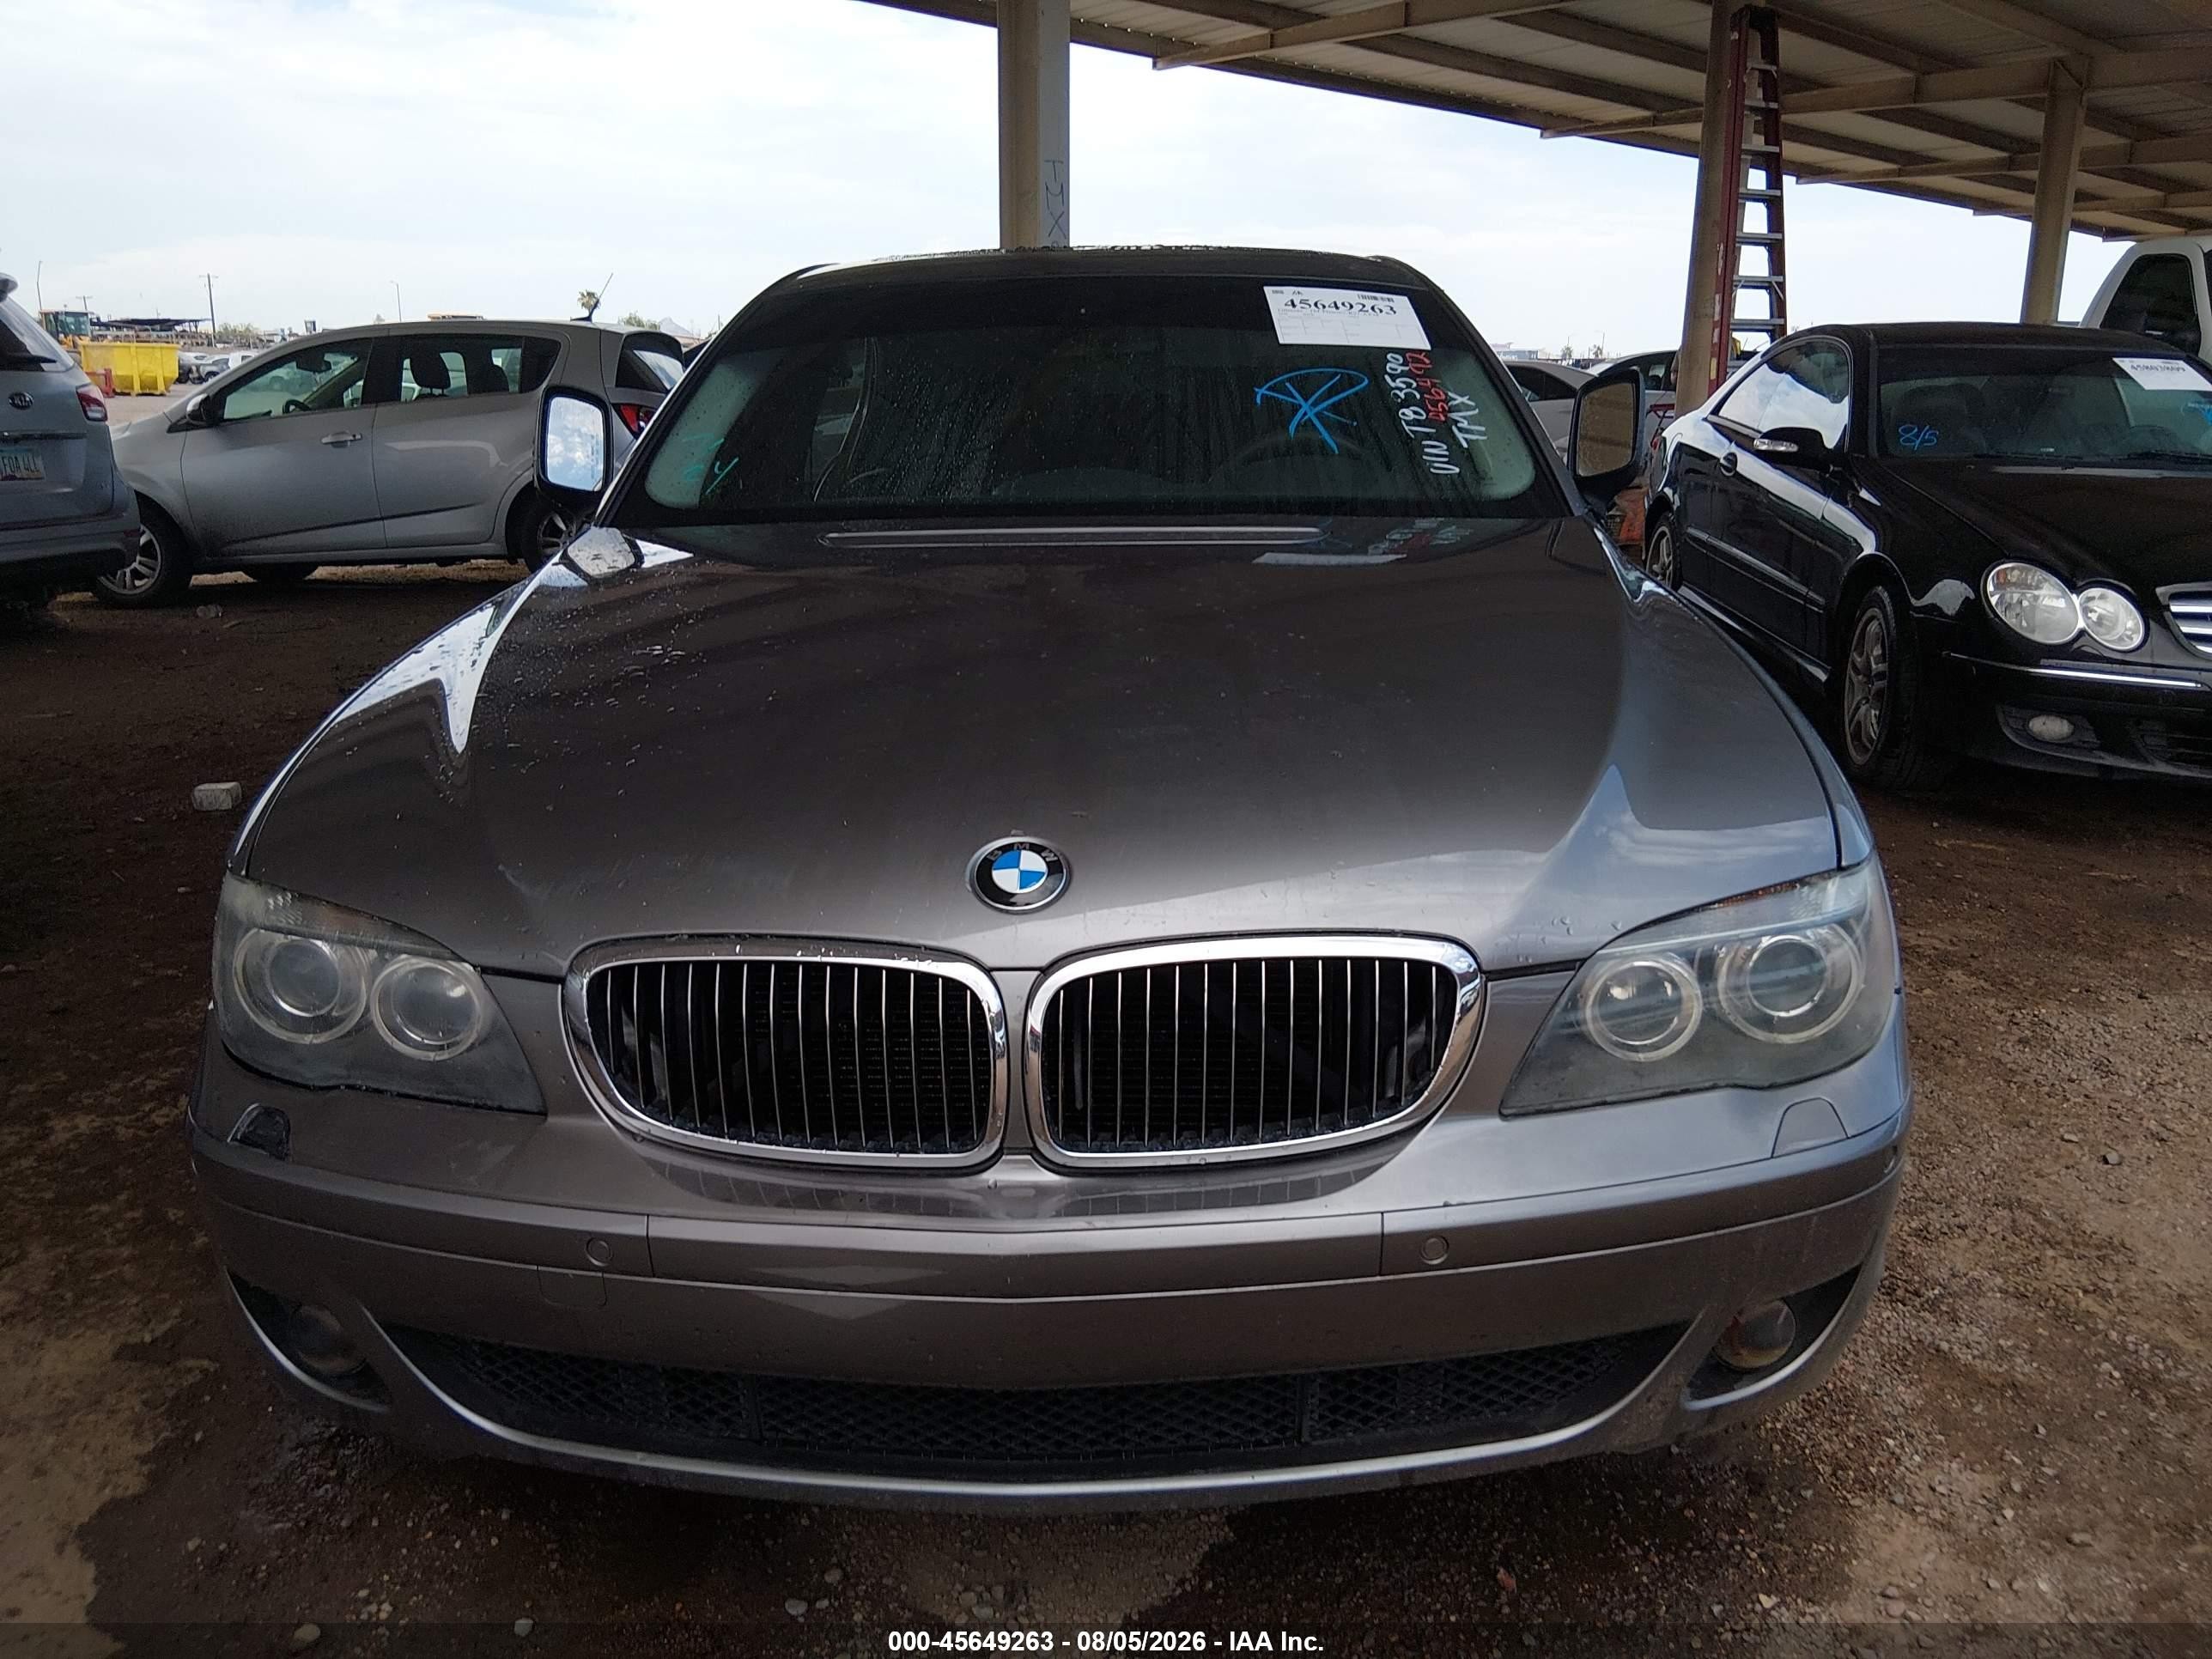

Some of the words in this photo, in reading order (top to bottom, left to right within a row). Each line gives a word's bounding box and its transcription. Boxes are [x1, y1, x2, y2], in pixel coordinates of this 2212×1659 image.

[1284, 297, 1397, 316] 45649263
[1421, 440, 1461, 474] VIN
[987, 842, 1059, 863] BMW
